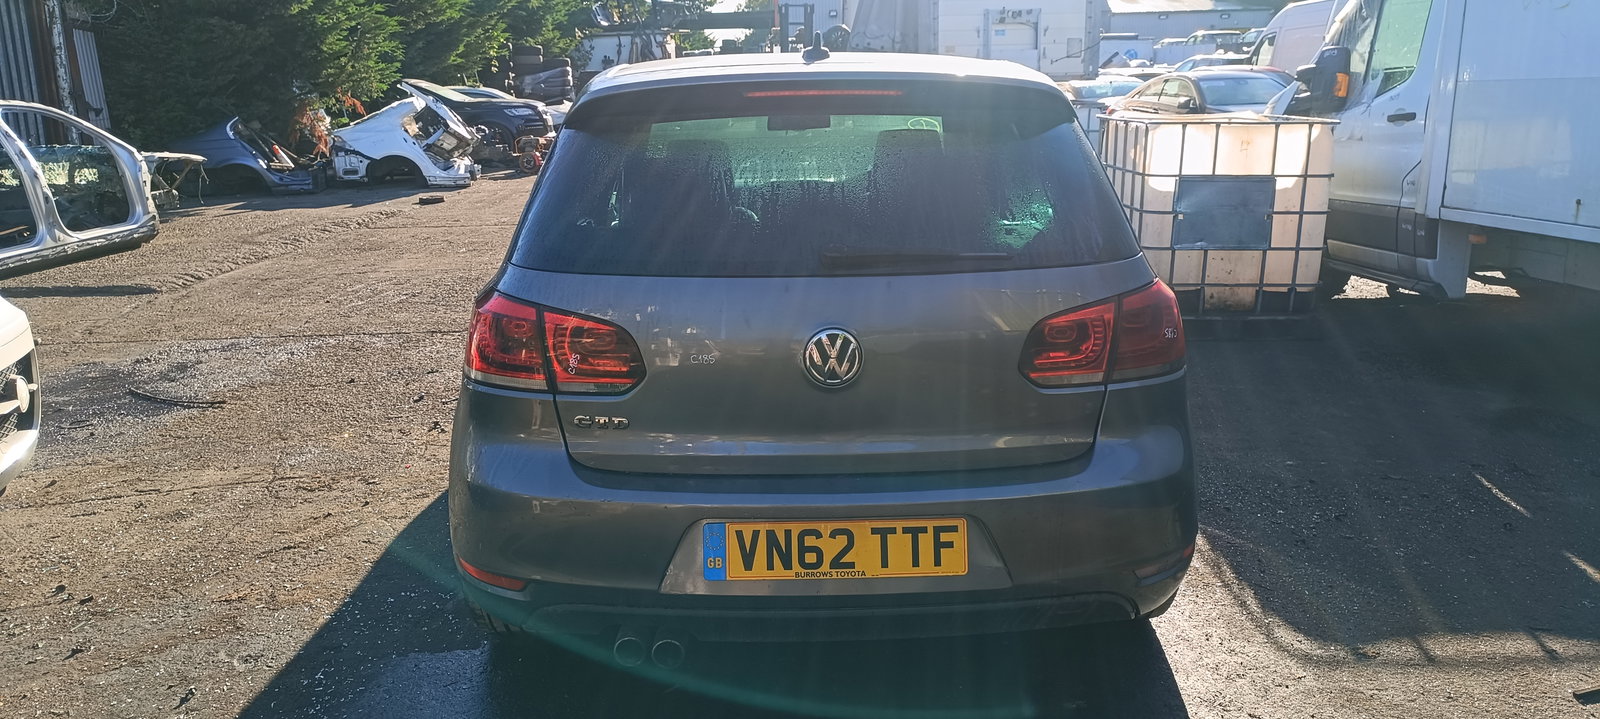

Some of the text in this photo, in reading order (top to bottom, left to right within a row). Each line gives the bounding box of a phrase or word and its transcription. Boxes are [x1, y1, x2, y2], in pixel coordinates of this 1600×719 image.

[690, 354, 716, 365] C185
[804, 328, 862, 386] VW
[573, 415, 630, 430] GTD
[734, 525, 959, 571] VN62 TTF
[707, 557, 722, 569] GB
[794, 570, 867, 579] BURROWS TOYOTA
